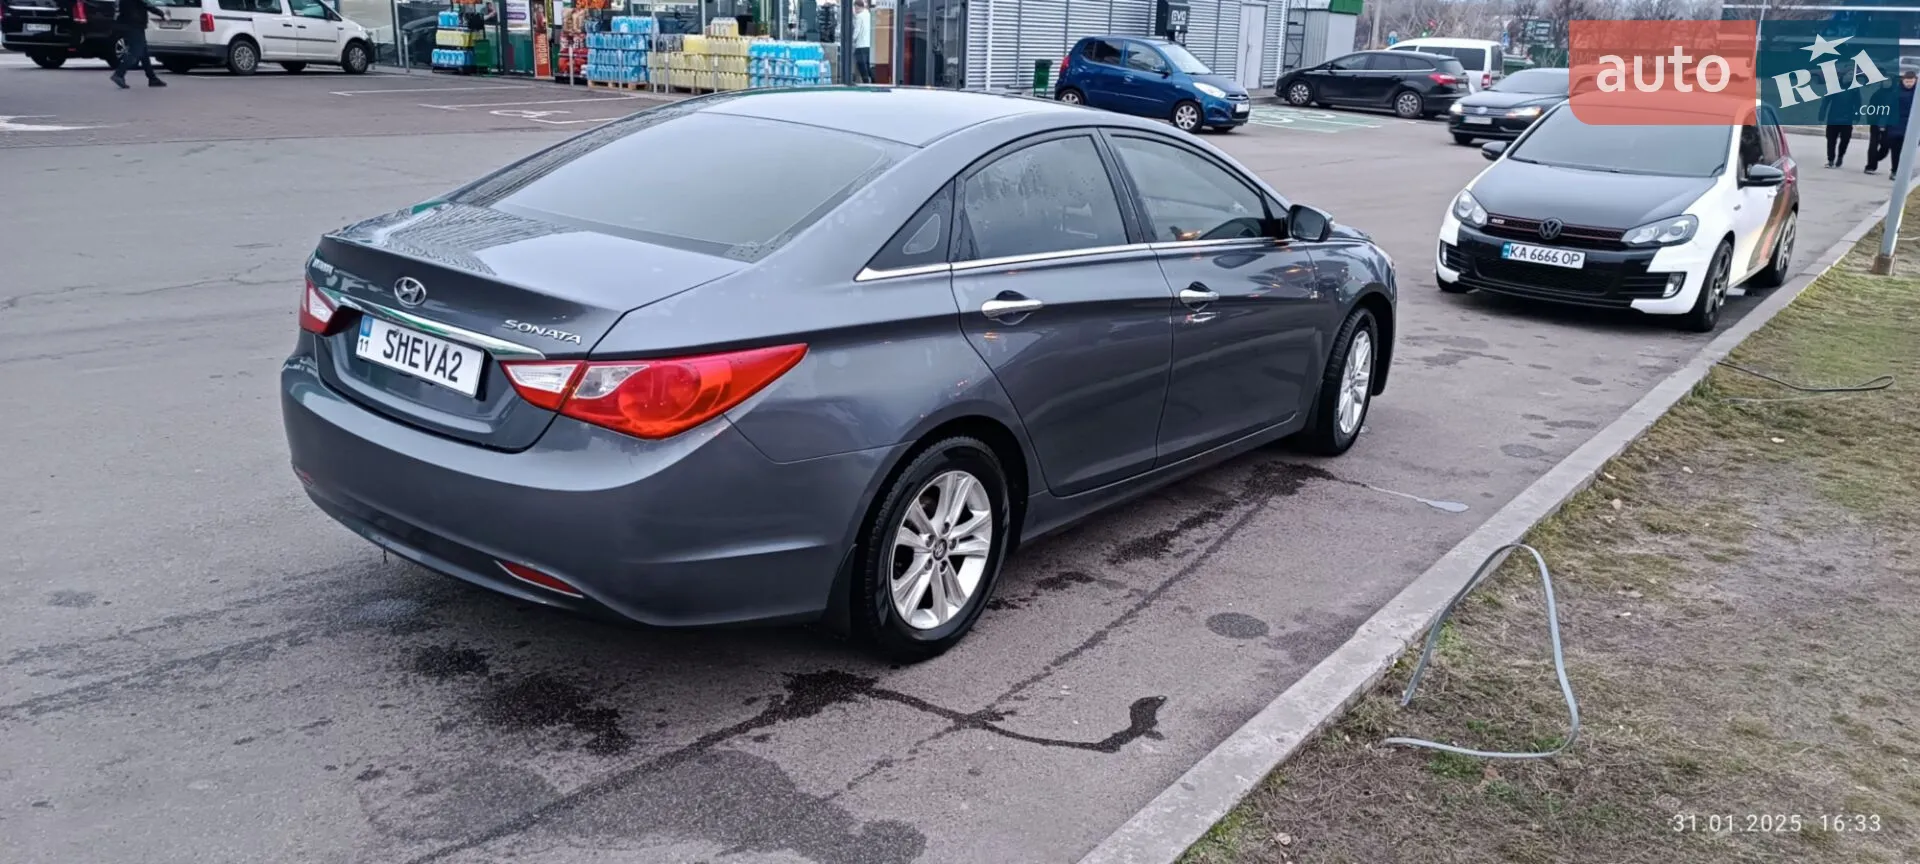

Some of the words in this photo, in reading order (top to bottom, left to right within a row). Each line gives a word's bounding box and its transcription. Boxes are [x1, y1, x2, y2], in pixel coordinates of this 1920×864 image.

[1509, 245, 1527, 259] KA
[1529, 248, 1559, 263] 6666
[1561, 252, 1581, 265] OP
[501, 319, 581, 345] SONATA
[359, 338, 369, 352] 11
[383, 329, 463, 383] SHEVA2
